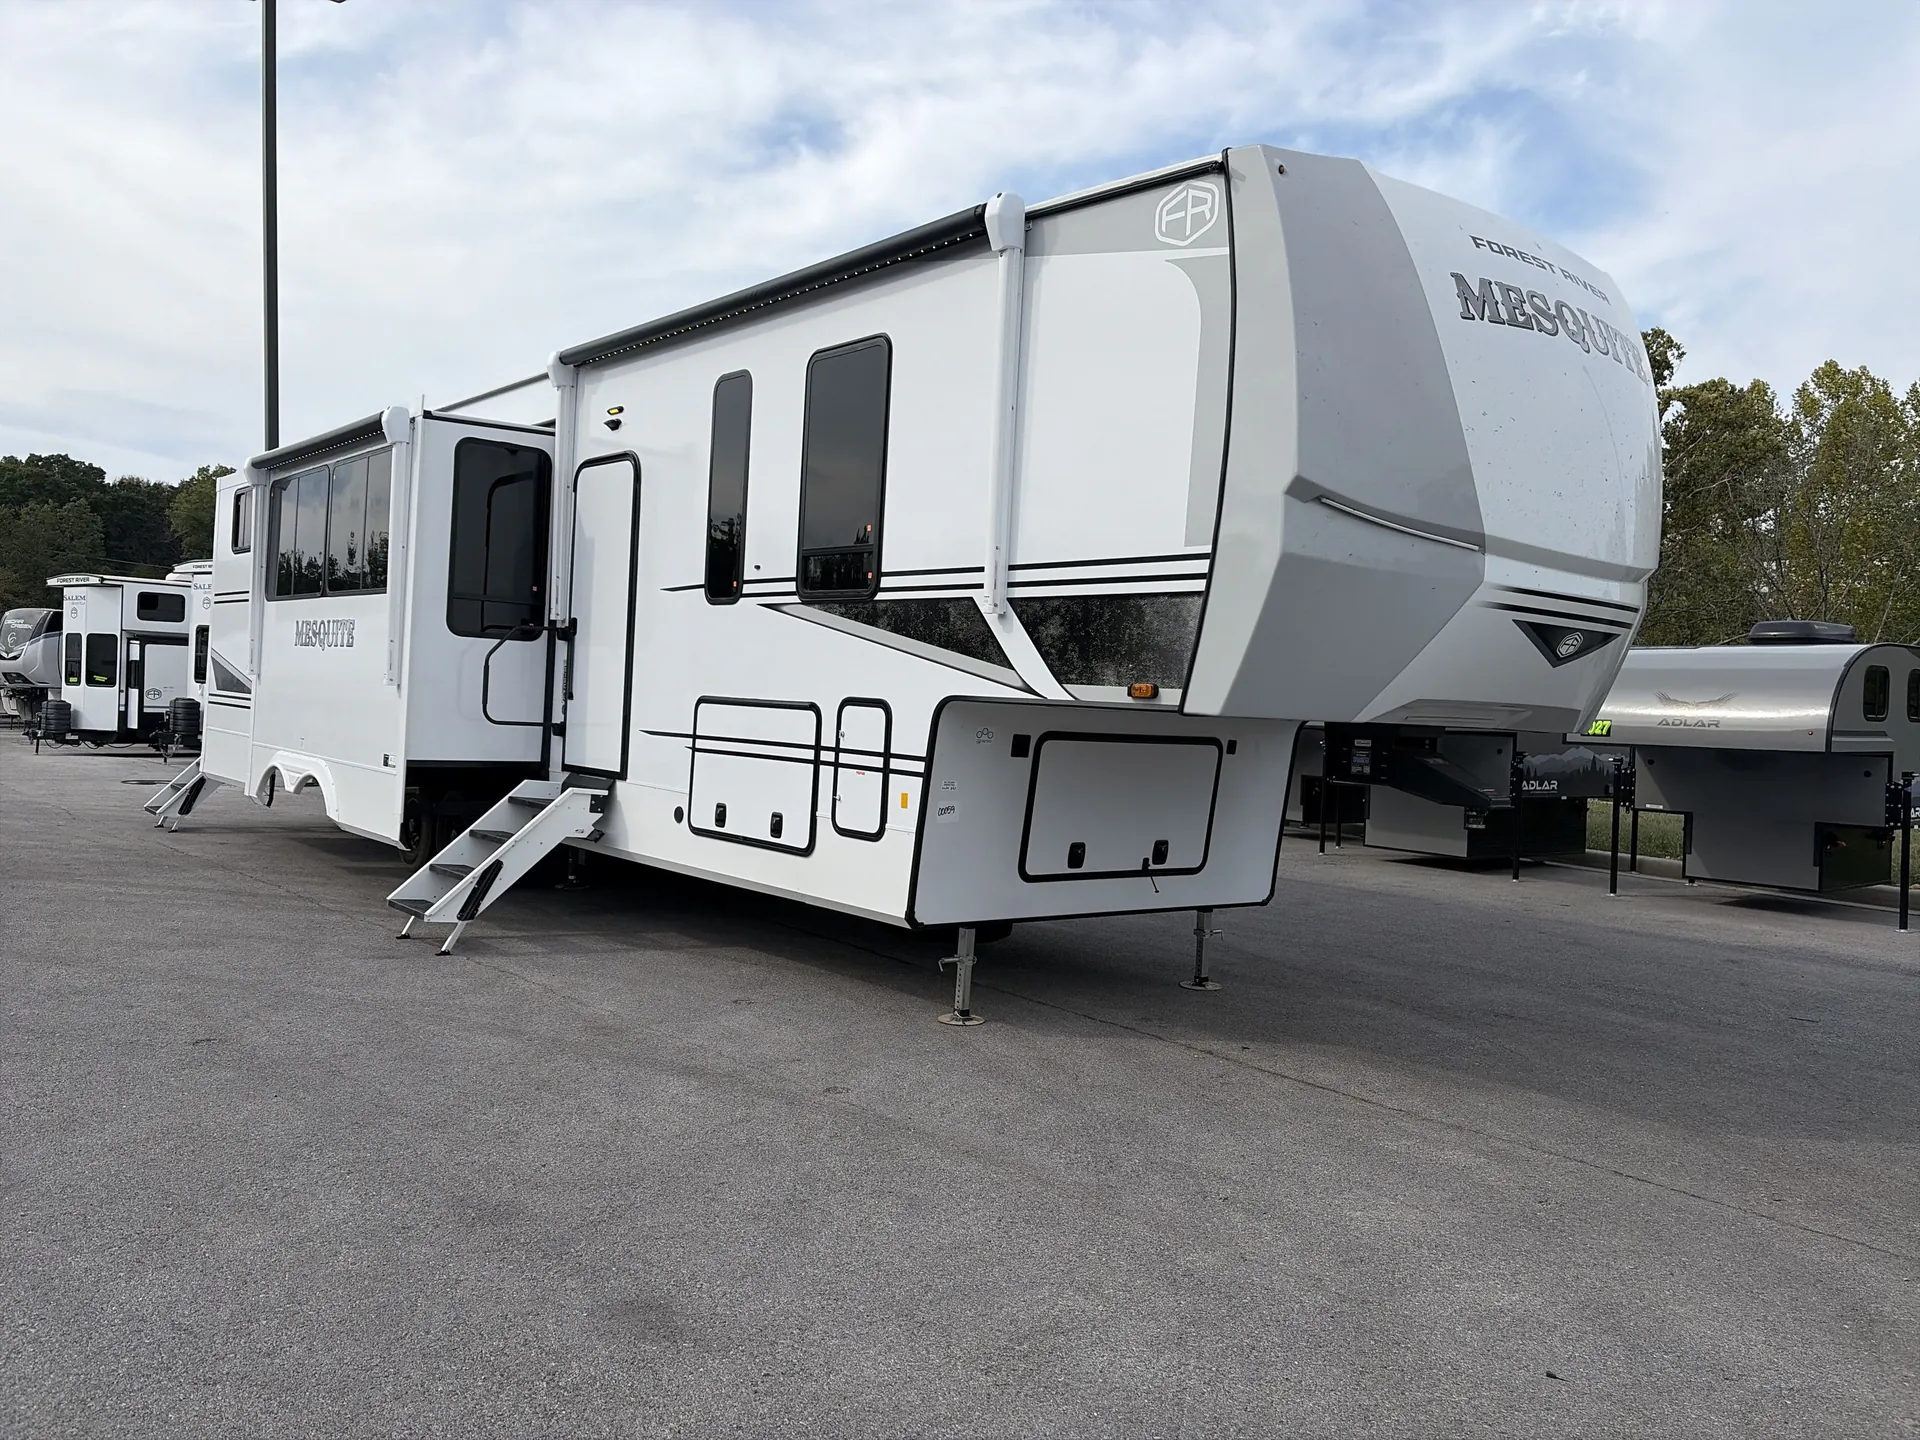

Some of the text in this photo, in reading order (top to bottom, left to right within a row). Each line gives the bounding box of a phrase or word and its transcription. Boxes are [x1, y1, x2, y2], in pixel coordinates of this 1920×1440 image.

[1470, 235, 1613, 306] FOREST RIVER
[1450, 271, 1649, 387] MESQUITE
[294, 619, 355, 651] MESQUITE
[1657, 718, 1720, 728] ADLAR
[1521, 780, 1558, 790] ADLAR
